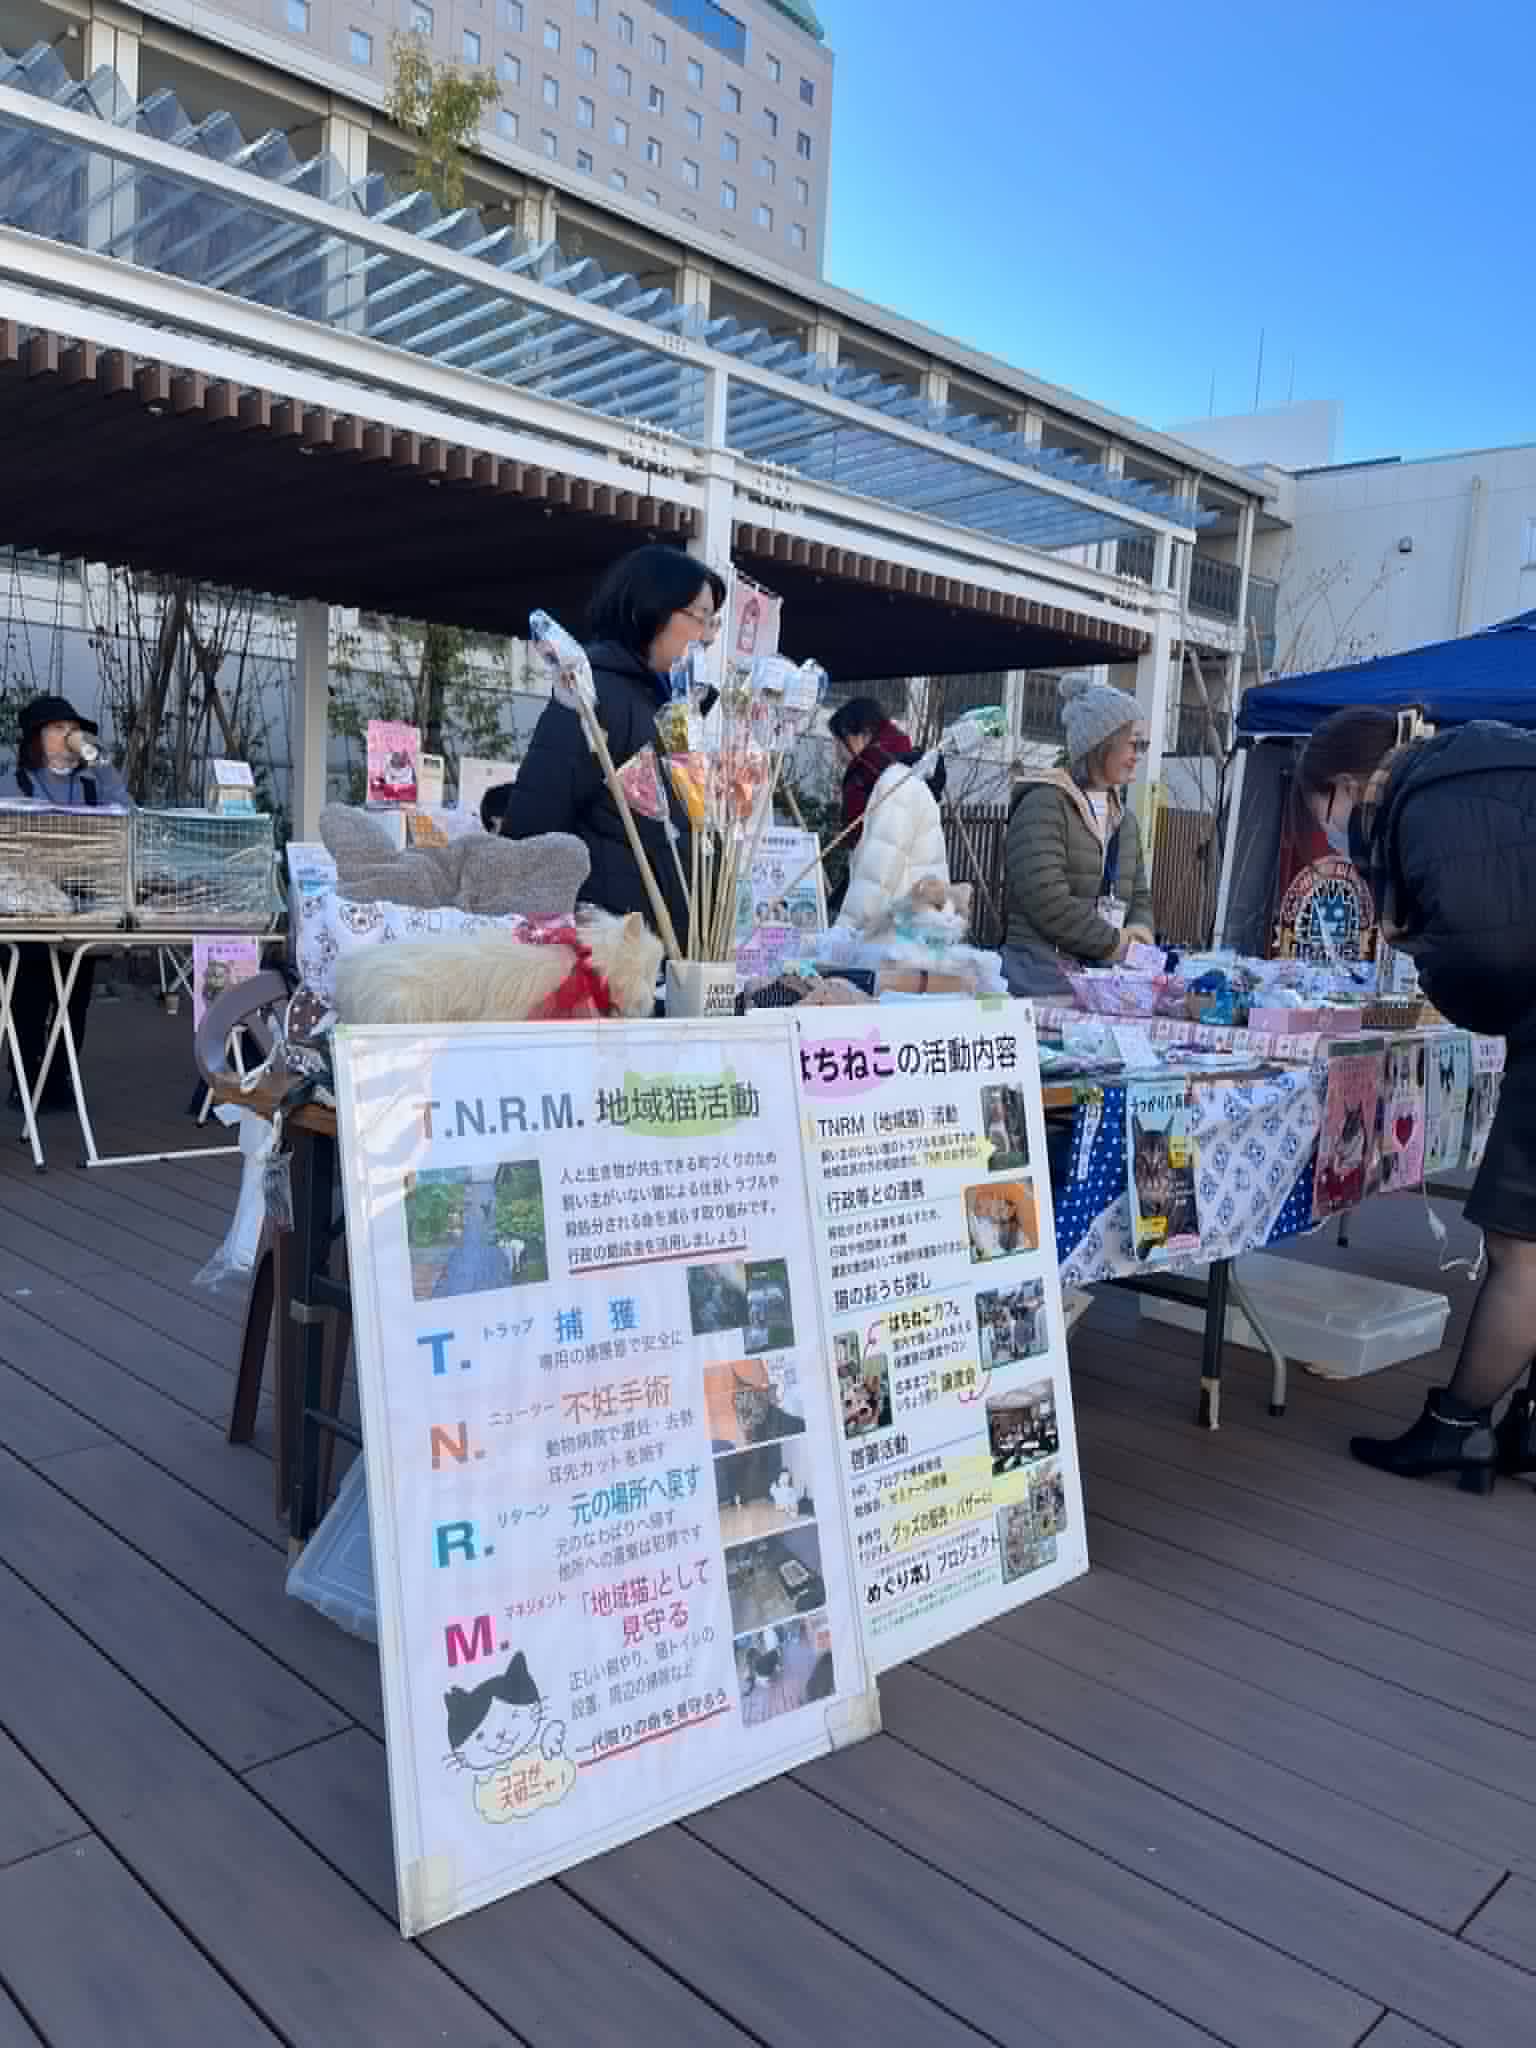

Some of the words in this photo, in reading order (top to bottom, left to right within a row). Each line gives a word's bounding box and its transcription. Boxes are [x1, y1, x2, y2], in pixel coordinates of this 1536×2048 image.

[596, 1080, 760, 1127] 地域猫活動
[482, 1316, 534, 1341] トラップ
[416, 1331, 472, 1376] T.
[489, 1402, 554, 1426] ニューター
[561, 1375, 670, 1424] 不妊手術
[430, 1421, 486, 1470] N.
[497, 1503, 550, 1528] リターン
[568, 1463, 701, 1528] 元の場所へ戻す
[435, 1521, 494, 1567] R.
[582, 1557, 711, 1617] 「地域猫」として
[444, 1613, 509, 1667] M.
[623, 1599, 688, 1648] 見守る
